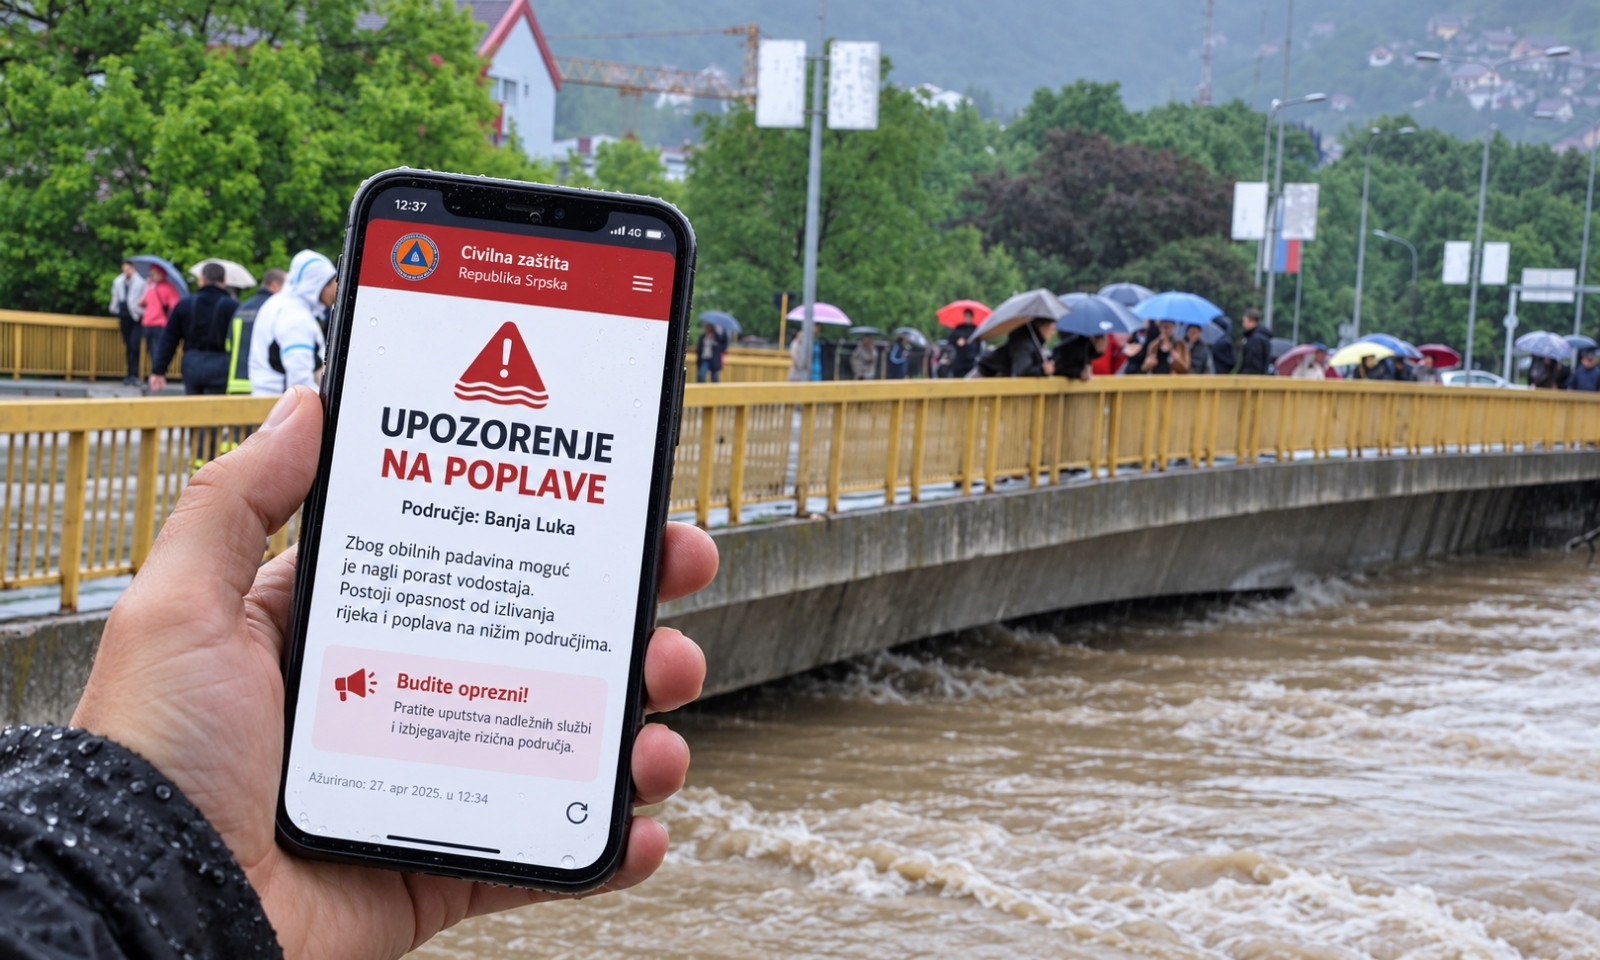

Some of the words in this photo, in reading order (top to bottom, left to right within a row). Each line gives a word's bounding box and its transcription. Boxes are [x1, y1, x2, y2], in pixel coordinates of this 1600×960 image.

[395, 199, 427, 212] 12:37
[627, 228, 642, 238] 4G
[461, 245, 513, 264] Civilna
[517, 253, 569, 271] zaštita
[459, 266, 521, 285] Republika
[525, 274, 568, 291] Srpska
[381, 406, 614, 464] UPOZORENJE
[381, 448, 432, 483] NA
[444, 456, 607, 505] POPLAVE
[402, 500, 479, 525] Područje:
[484, 510, 530, 532] Banja
[536, 517, 575, 536] Luka
[345, 535, 384, 557] Zbog
[388, 541, 440, 561] obilnih
[445, 551, 513, 570] padavina
[519, 561, 570, 579] moguć
[341, 558, 357, 576] je
[361, 563, 398, 581] nagli
[403, 569, 452, 586] porast
[457, 575, 534, 598] vodostaja.
[340, 581, 391, 604] Postoji
[396, 592, 466, 611] opasnost
[470, 599, 490, 614] od
[494, 601, 554, 625] izlivanja
[336, 605, 378, 623] rijeka
[383, 610, 388, 624] i
[391, 614, 451, 632] poplava
[457, 623, 475, 635] na
[480, 623, 520, 641] nižim
[524, 631, 611, 652] područjima.
[397, 673, 453, 694] Budite
[458, 684, 529, 703] oprezni!
[394, 701, 435, 717] Pratite
[438, 709, 491, 724] uputstva
[495, 714, 553, 730] nadležnih
[557, 720, 592, 734] službi
[391, 721, 395, 733] i
[399, 722, 471, 743] izbjegavajte
[475, 731, 514, 747] rizična
[518, 737, 574, 755] područja.
[308, 772, 366, 789] Ažurirano:
[369, 779, 386, 792] 27.
[389, 784, 409, 796] apr
[411, 785, 442, 799] 2025.
[446, 792, 454, 800] u
[458, 791, 488, 805] 12:34
